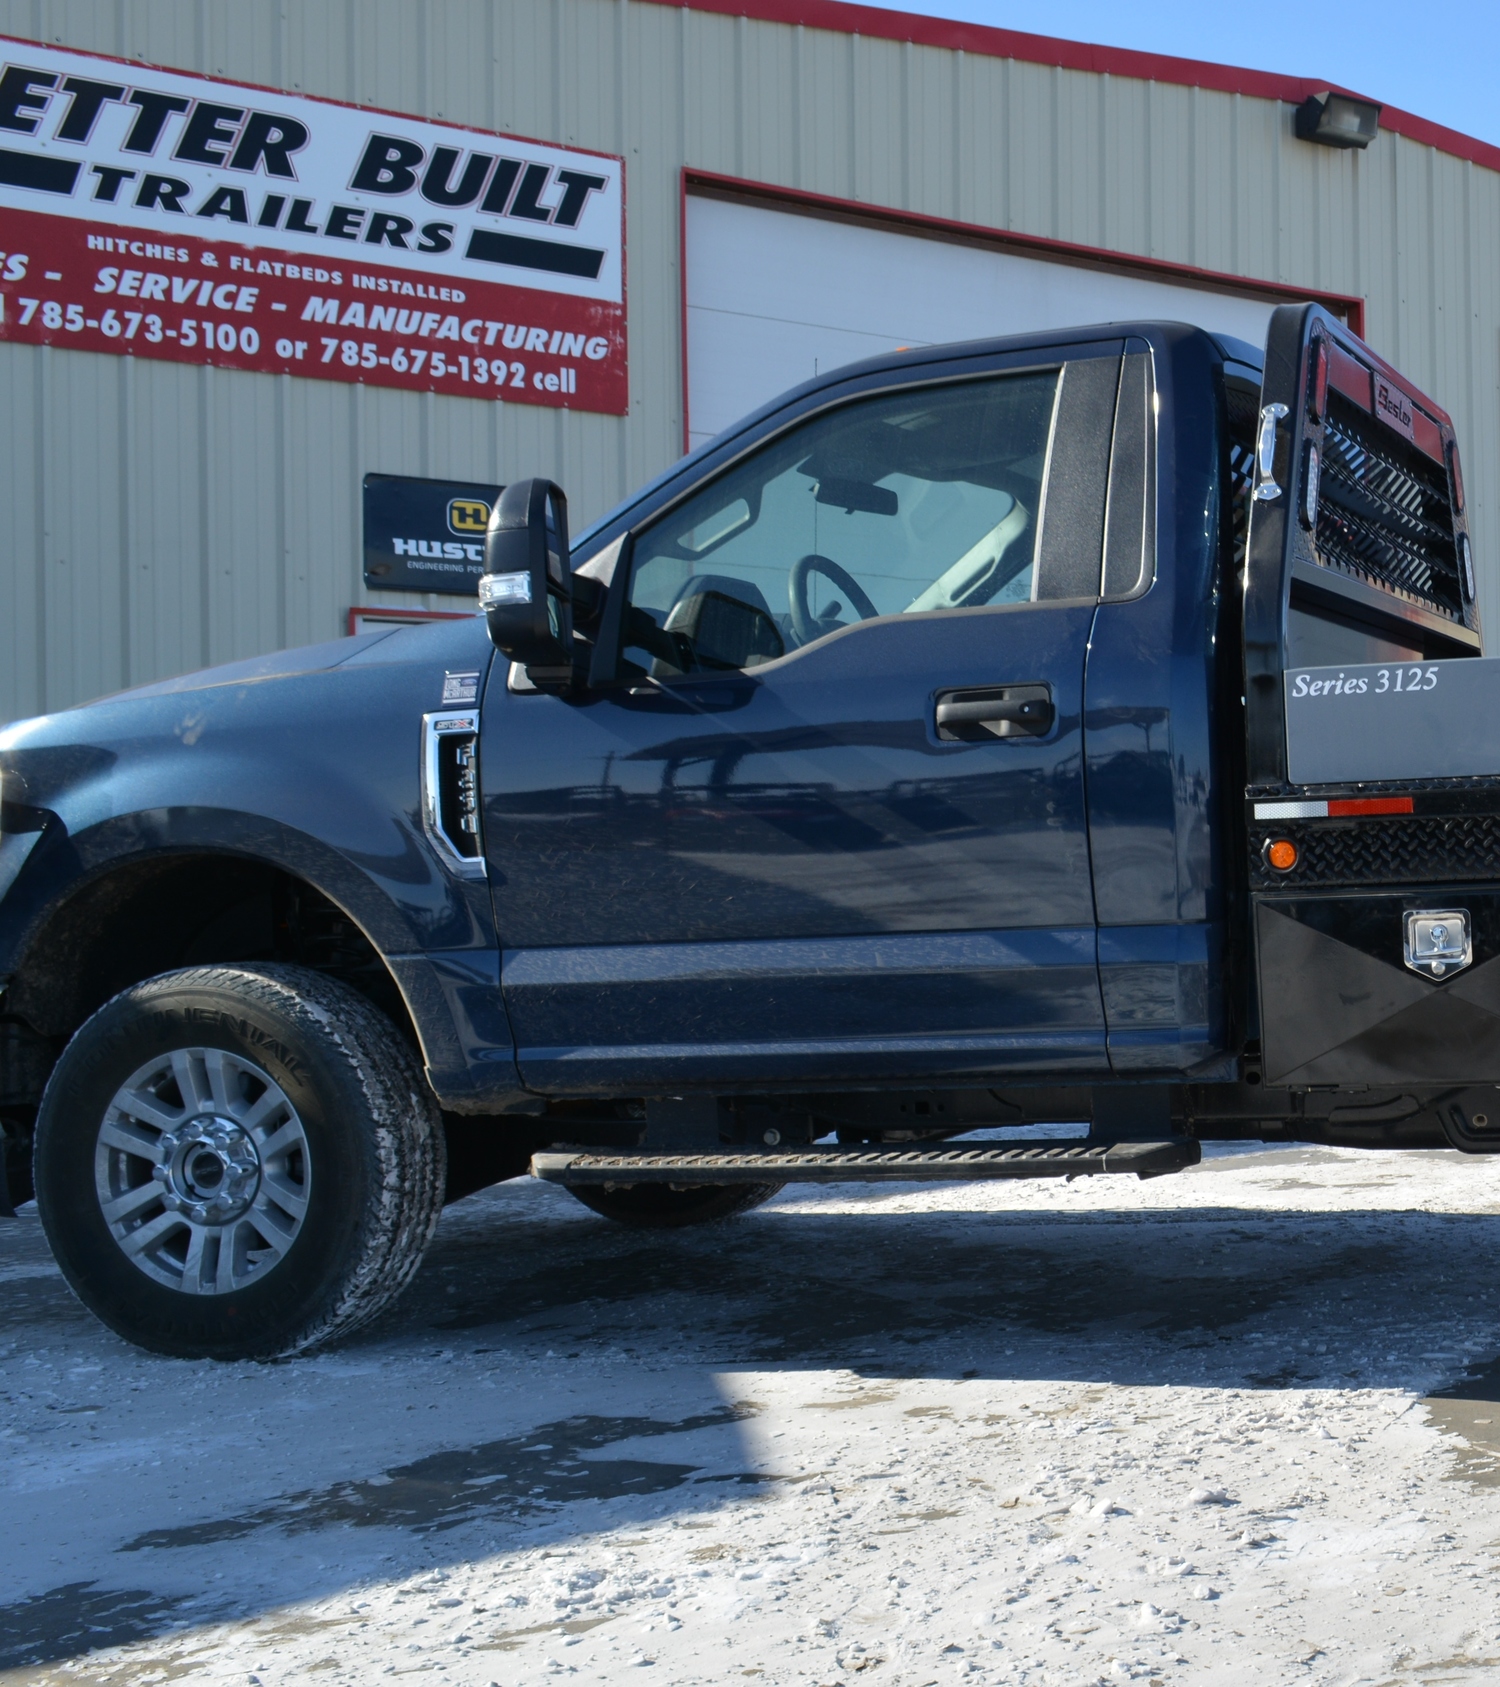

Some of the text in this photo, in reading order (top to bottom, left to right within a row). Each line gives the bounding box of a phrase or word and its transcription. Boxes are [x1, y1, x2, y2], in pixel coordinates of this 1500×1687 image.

[88, 164, 456, 255] TRAILERS
[348, 131, 608, 229] BUILT
[87, 234, 467, 303] HITCHES & FLATBEDS INSTALLED
[18, 297, 260, 355] 785-673-5100
[275, 338, 308, 360] or
[320, 337, 526, 389] 785-675-1392
[533, 367, 576, 394] cell
[93, 266, 260, 313] SERVICE
[301, 296, 609, 360] MANUFACTURING
[392, 537, 485, 562] HUST
[407, 560, 464, 573] ENGINEERING
[1292, 666, 1439, 698] Series 3125
